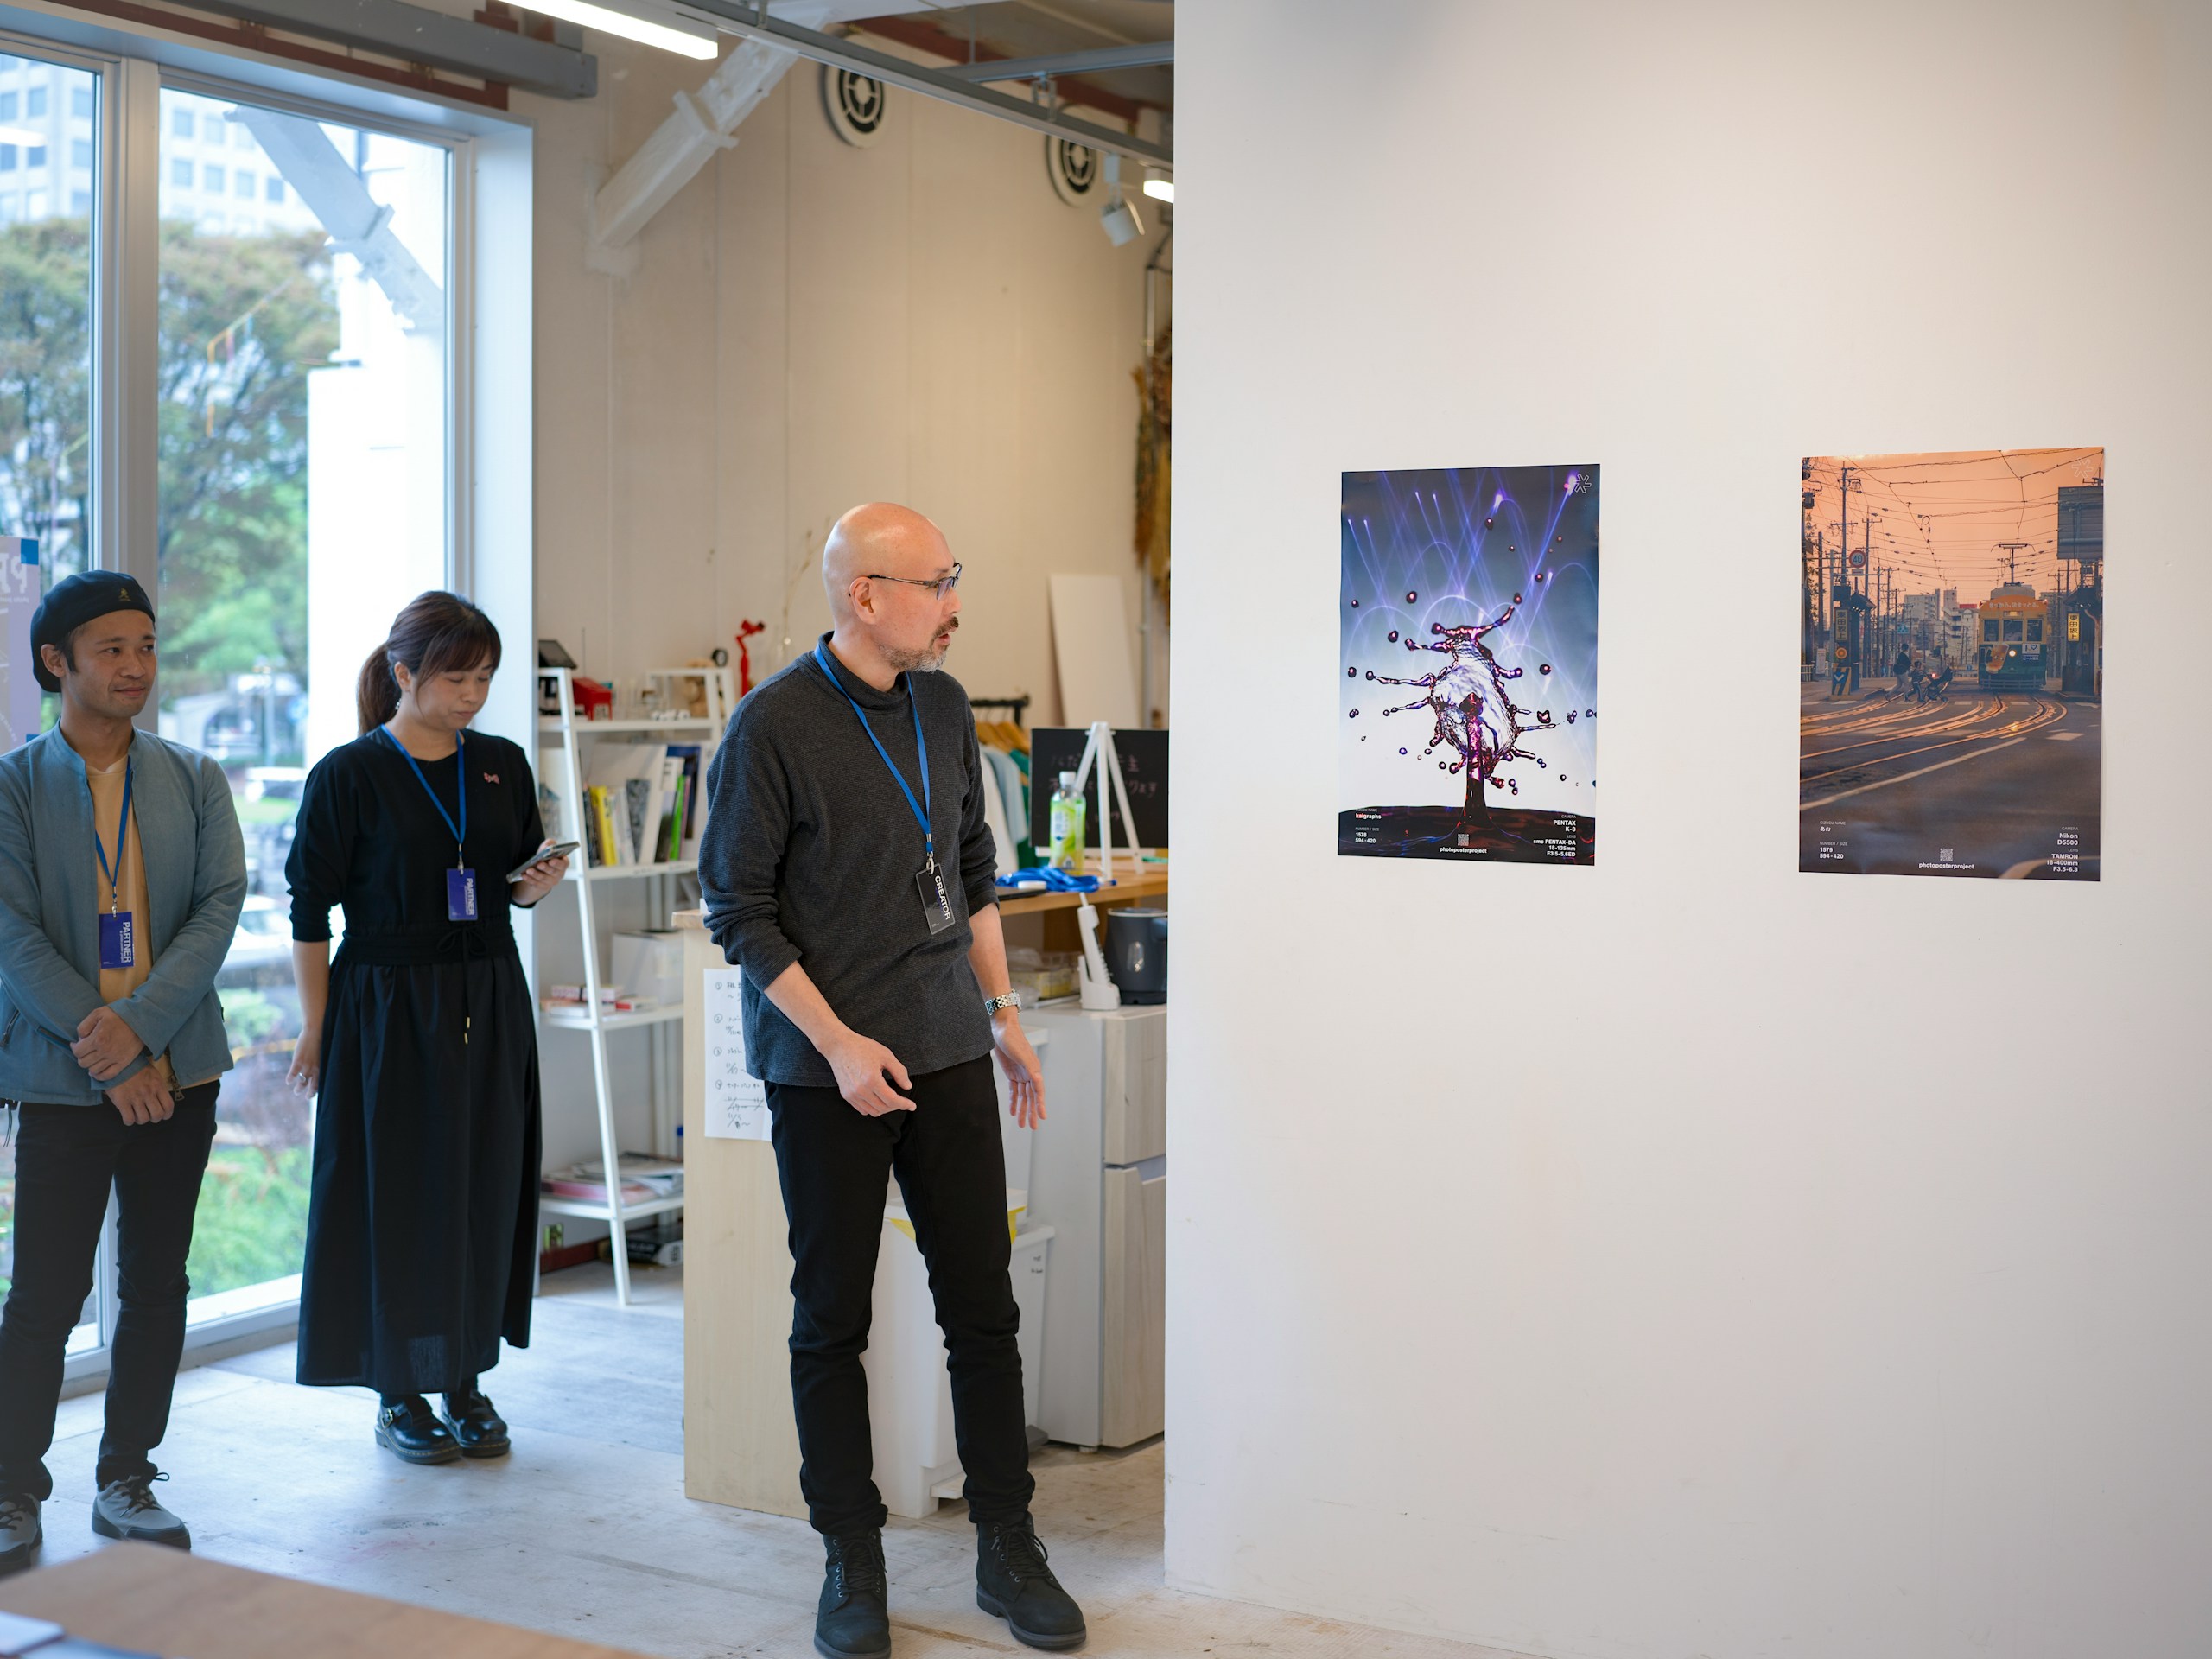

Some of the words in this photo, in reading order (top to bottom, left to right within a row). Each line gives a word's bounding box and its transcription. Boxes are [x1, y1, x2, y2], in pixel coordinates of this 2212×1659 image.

[1853, 555, 1862, 563] 40
[2069, 614, 2078, 640] 東田坂上
[934, 875, 951, 920] CREATOR
[123, 921, 132, 963] PARTNER
